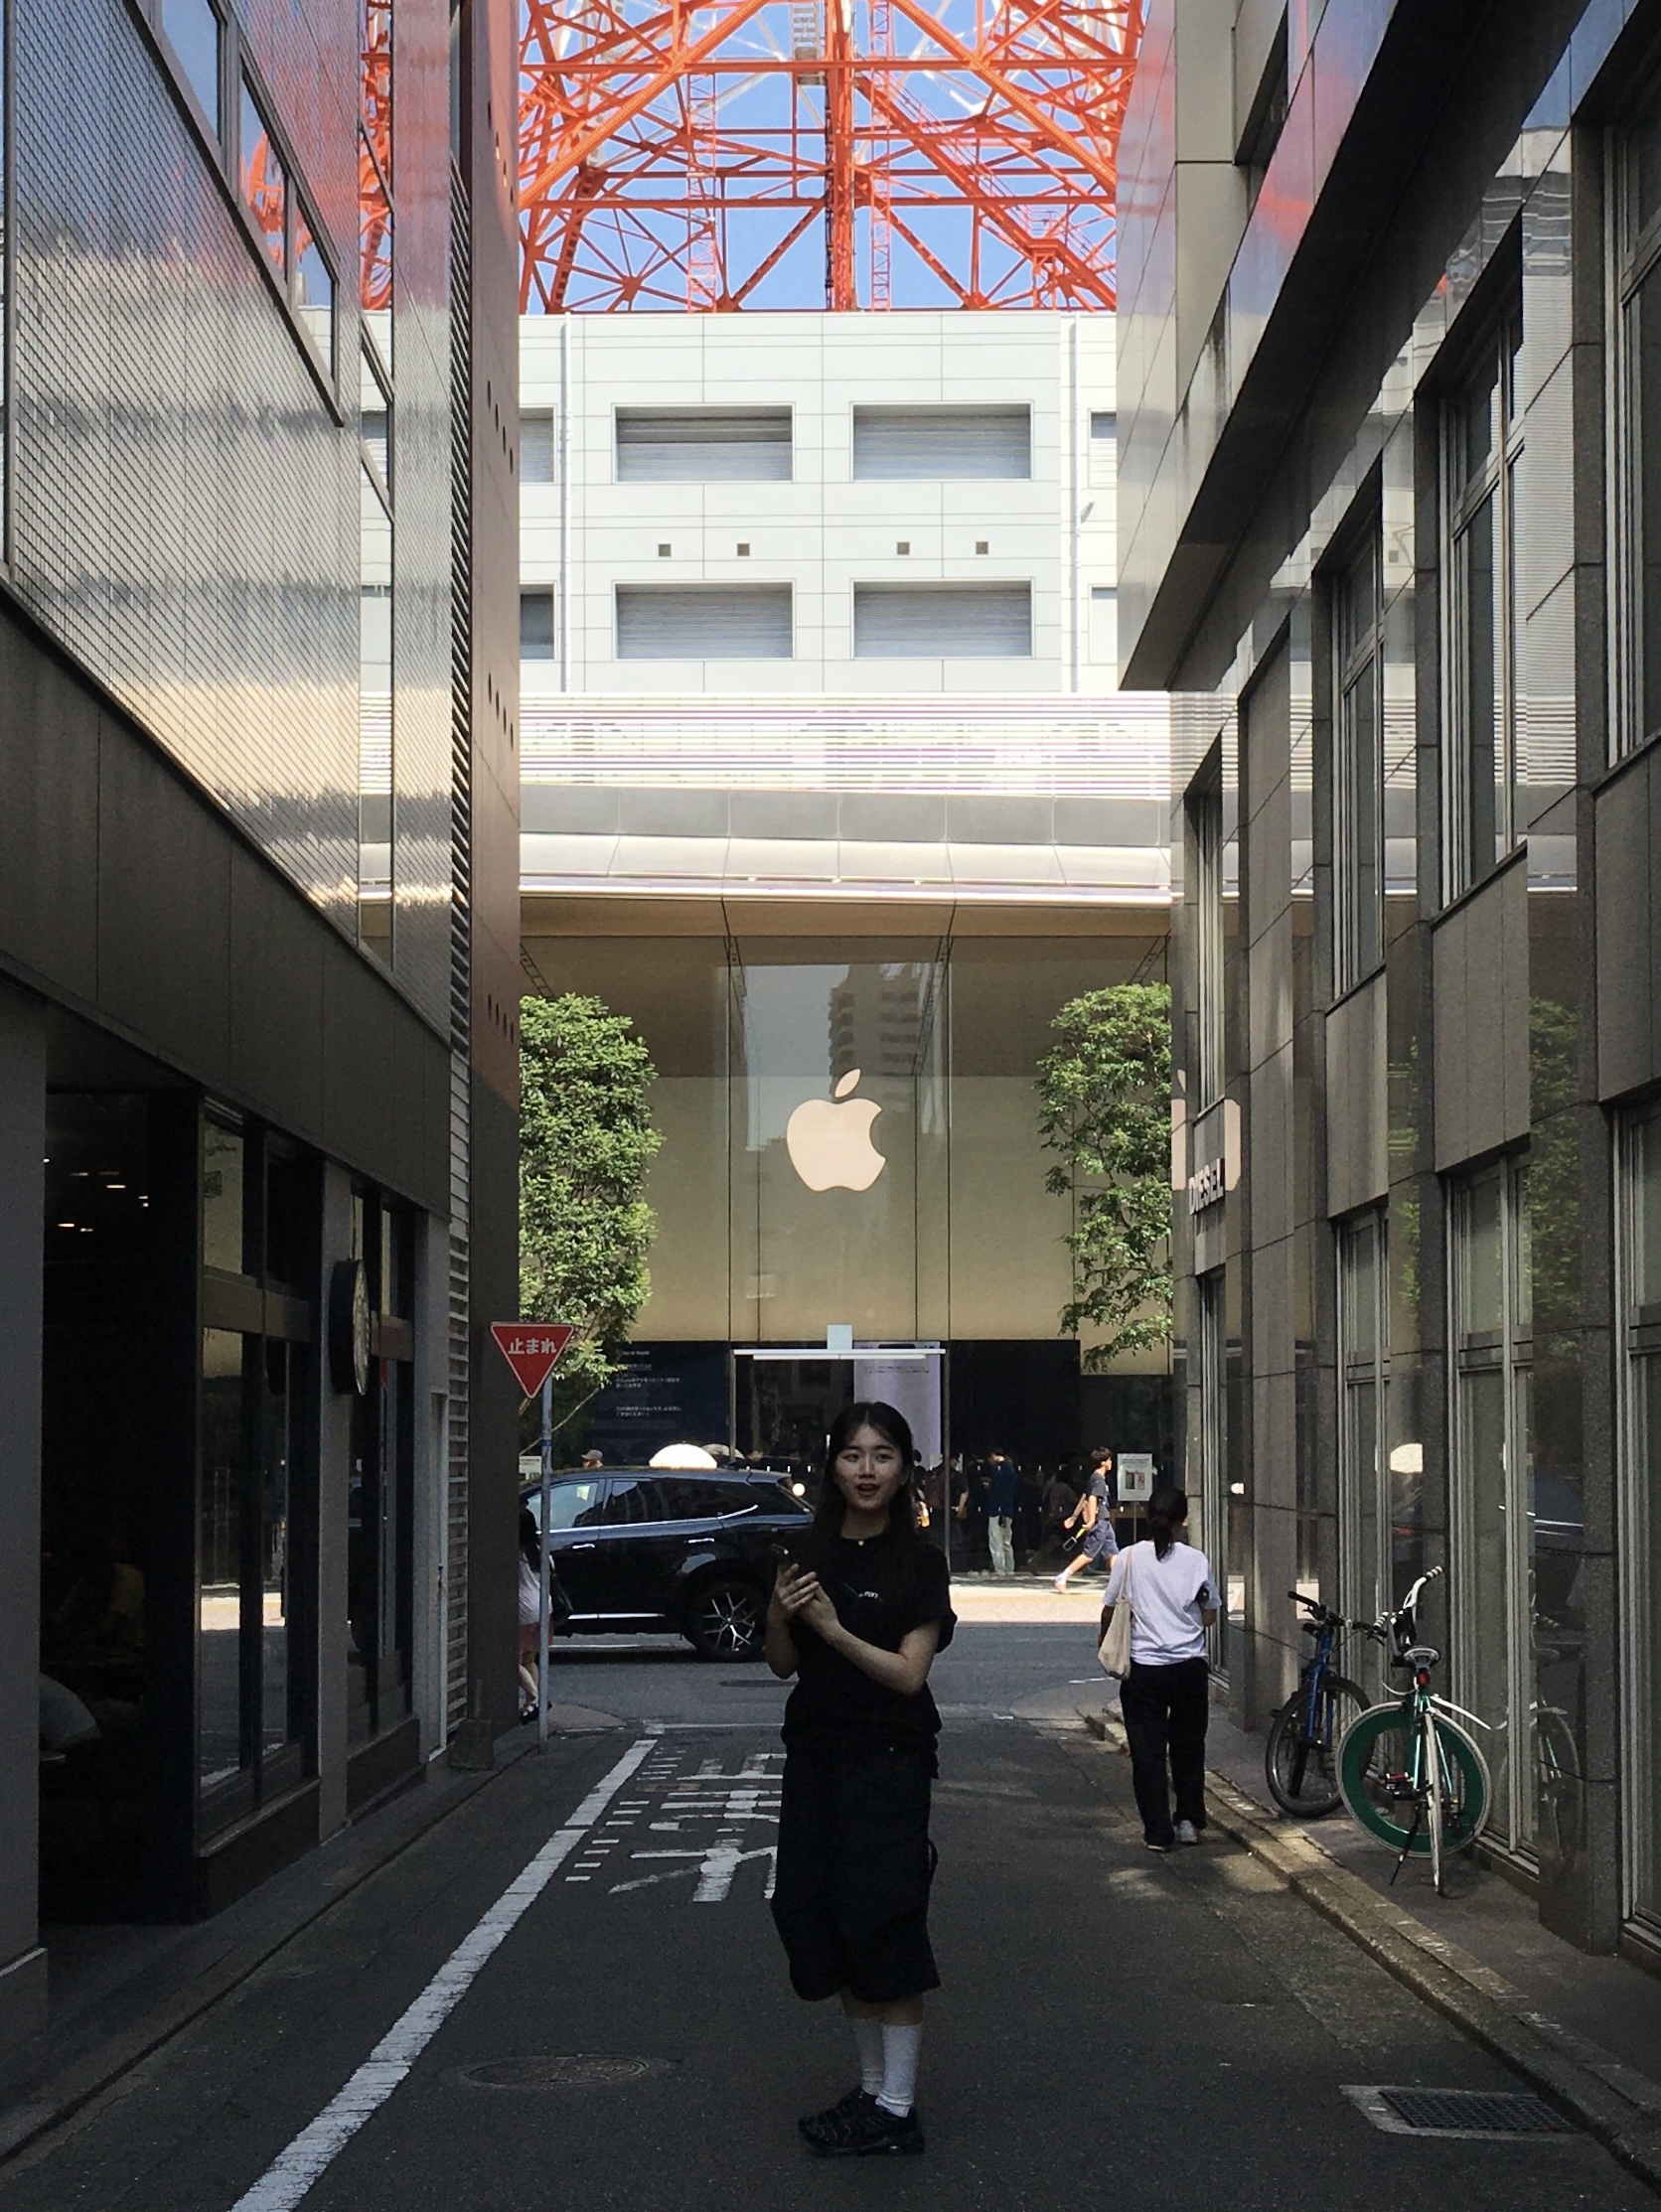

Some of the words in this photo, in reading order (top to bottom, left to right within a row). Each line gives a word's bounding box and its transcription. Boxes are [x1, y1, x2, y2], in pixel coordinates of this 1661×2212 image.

[1188, 1157, 1225, 1216] DIESEL
[508, 1337, 557, 1355] 止まれ
